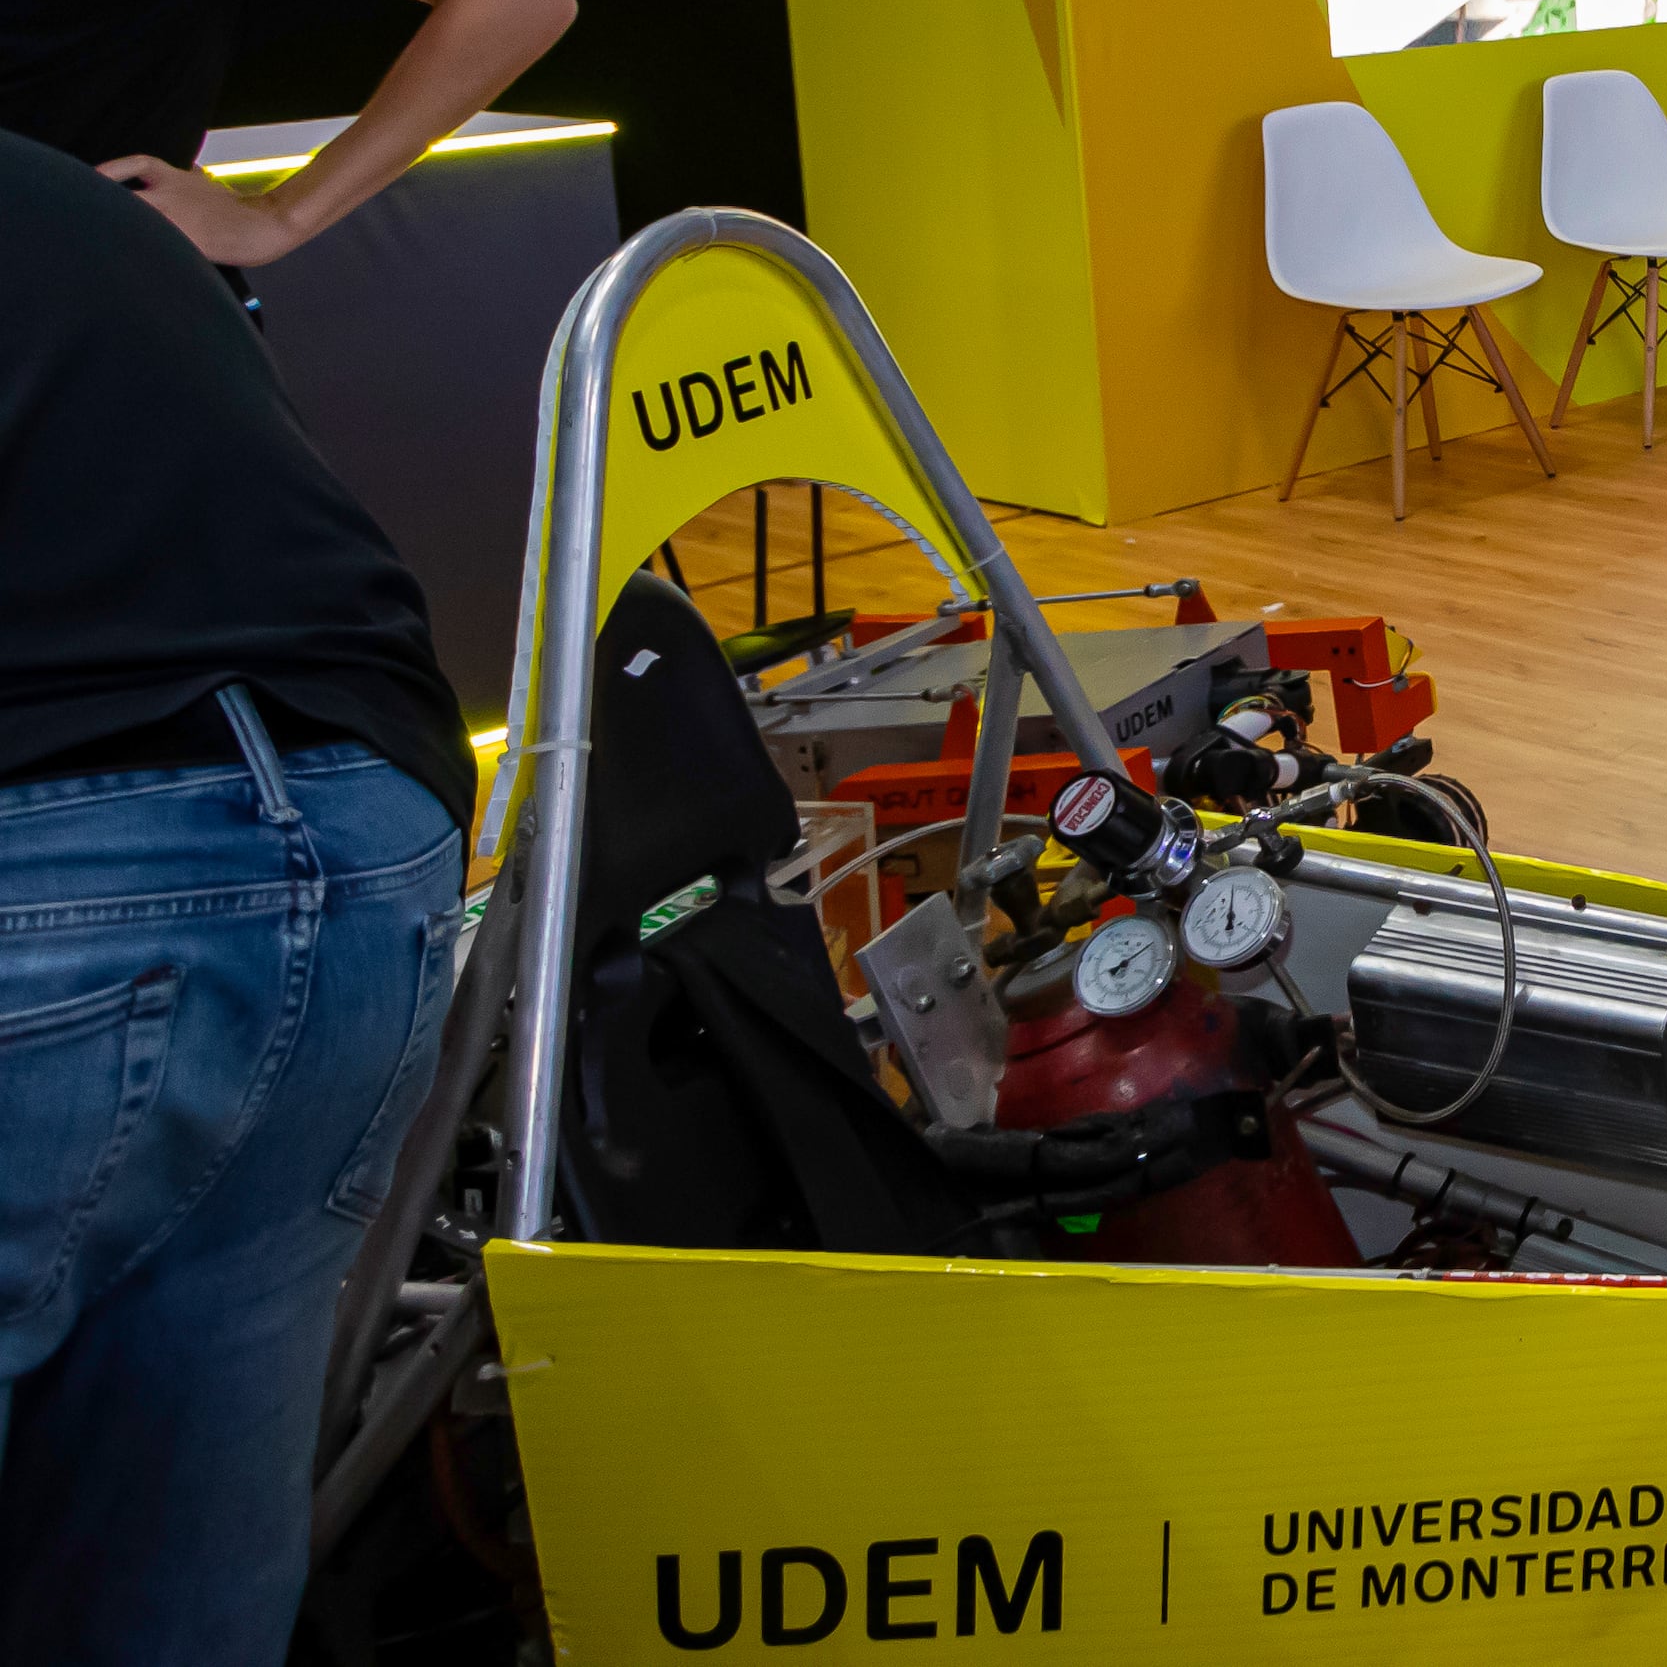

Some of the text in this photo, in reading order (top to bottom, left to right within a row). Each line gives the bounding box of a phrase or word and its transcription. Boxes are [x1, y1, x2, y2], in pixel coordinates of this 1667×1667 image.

[631, 340, 813, 452] UDEM
[1116, 694, 1174, 742] UDEM
[1263, 1484, 1665, 1556] UNIVERSIDAD
[656, 1529, 1064, 1652] UDEM
[1261, 1567, 1338, 1616] DE
